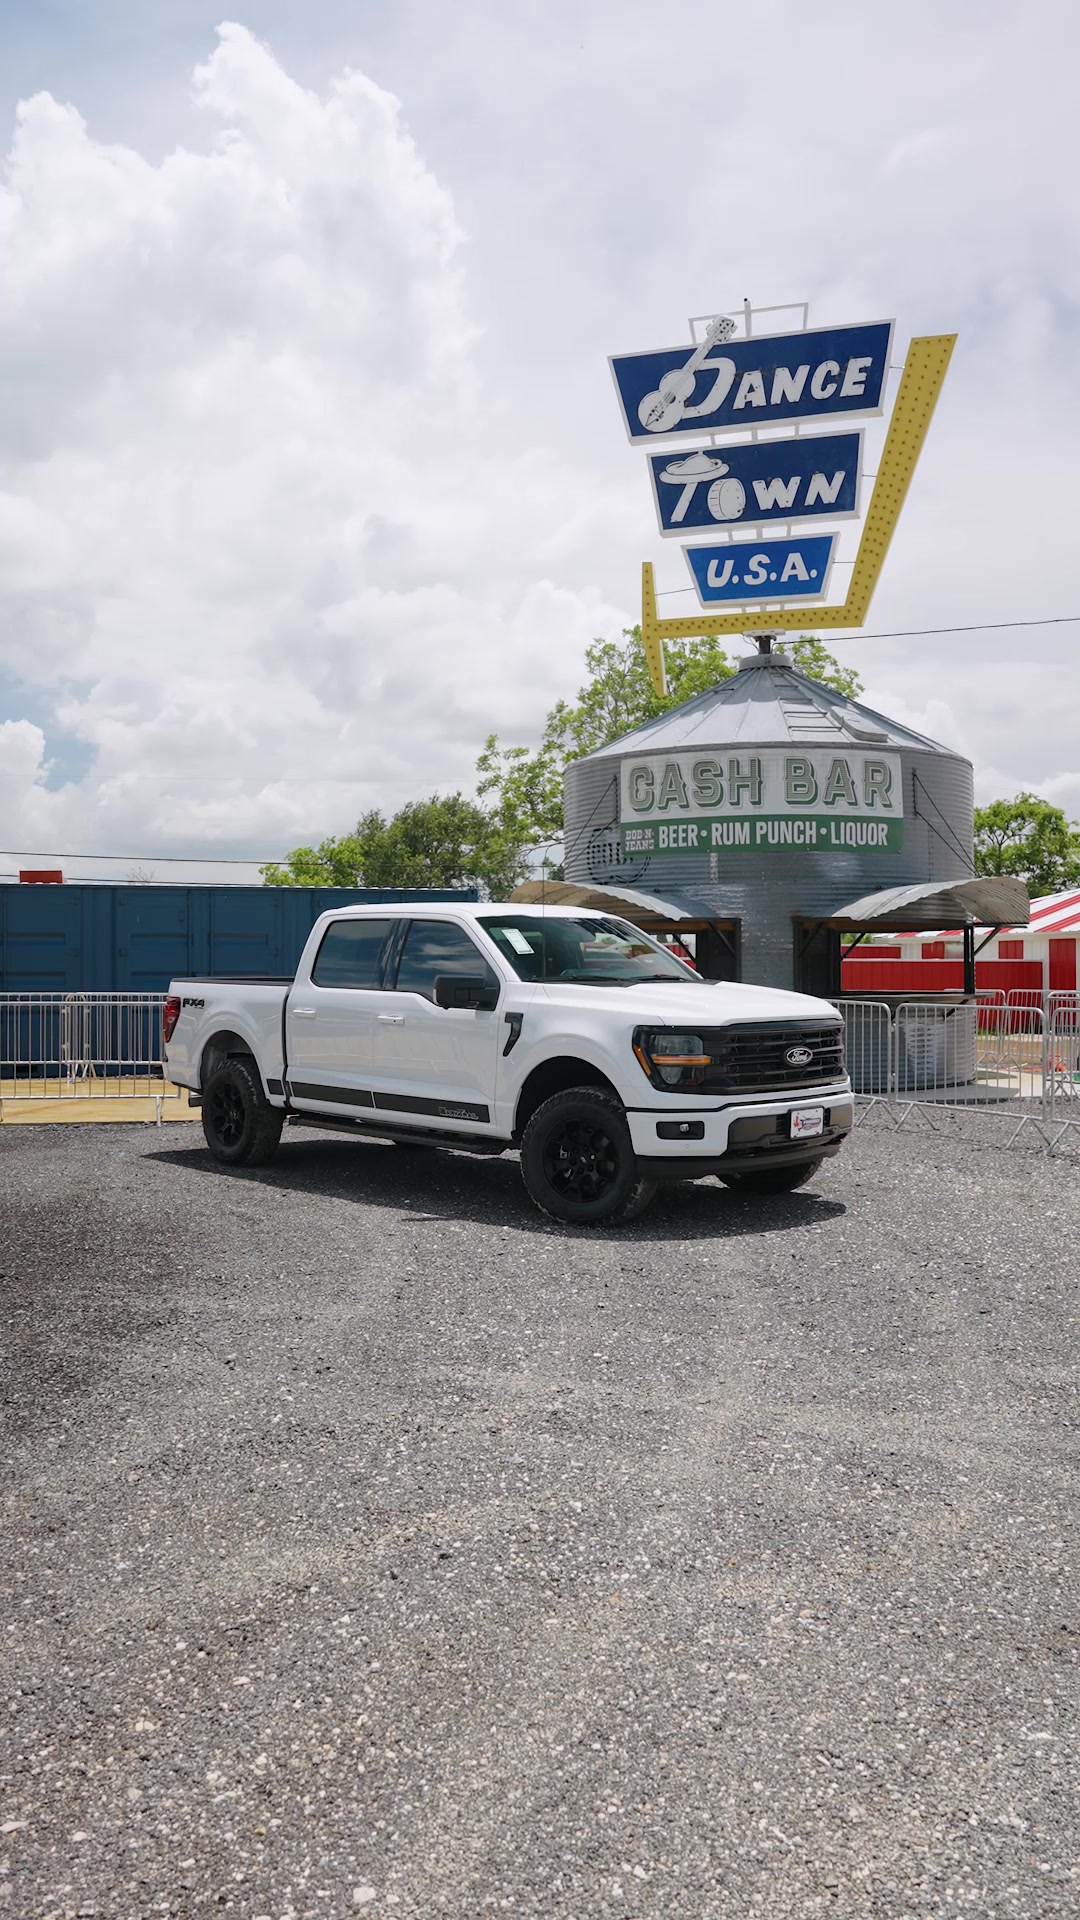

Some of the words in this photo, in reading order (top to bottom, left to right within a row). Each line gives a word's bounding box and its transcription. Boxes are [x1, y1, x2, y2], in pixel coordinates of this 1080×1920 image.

[638, 356, 872, 432] DANCE
[659, 453, 846, 523] TOWN
[706, 553, 817, 588] U.S.A.
[629, 757, 763, 812] CASH
[784, 756, 892, 808] BAR
[625, 840, 654, 851] JEANS
[658, 824, 699, 848] BEER
[711, 822, 750, 846] RUM
[756, 821, 816, 844] PUNCH
[830, 822, 888, 847] LIQUOR
[182, 998, 205, 1008] FX4
[789, 1049, 809, 1062] Ford
